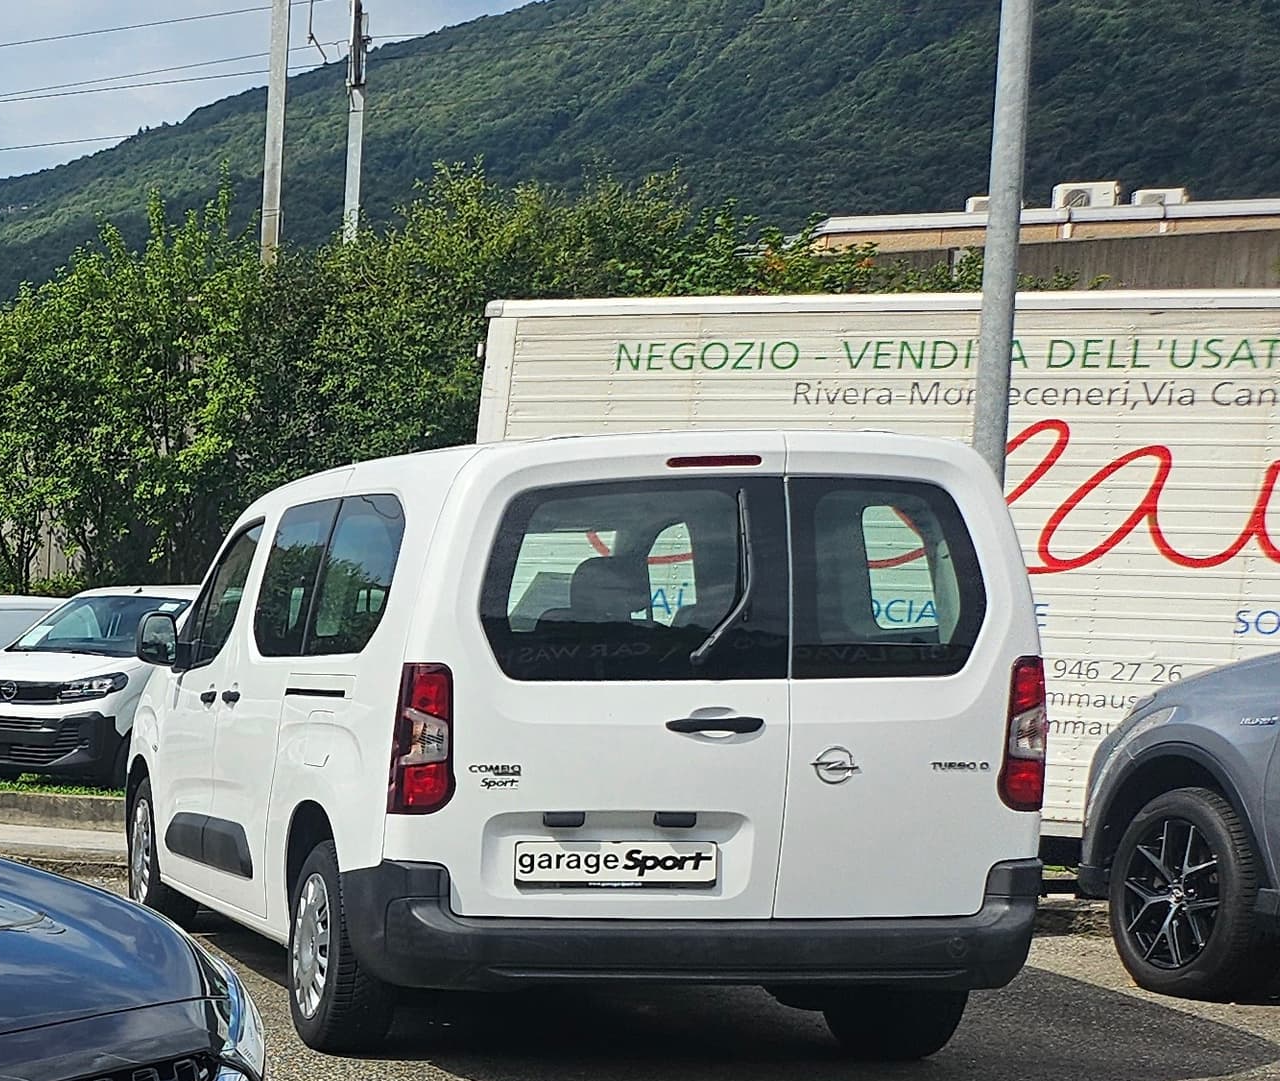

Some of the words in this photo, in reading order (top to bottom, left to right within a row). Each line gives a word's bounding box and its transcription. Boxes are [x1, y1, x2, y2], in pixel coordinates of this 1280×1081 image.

[615, 342, 800, 371] NEGOZIO
[843, 339, 1028, 369] VENDIA
[1053, 660, 1100, 680] 946
[1110, 662, 1142, 682] 27
[1150, 664, 1183, 683] 26
[930, 761, 977, 771] TURBO
[480, 777, 519, 790] Sport
